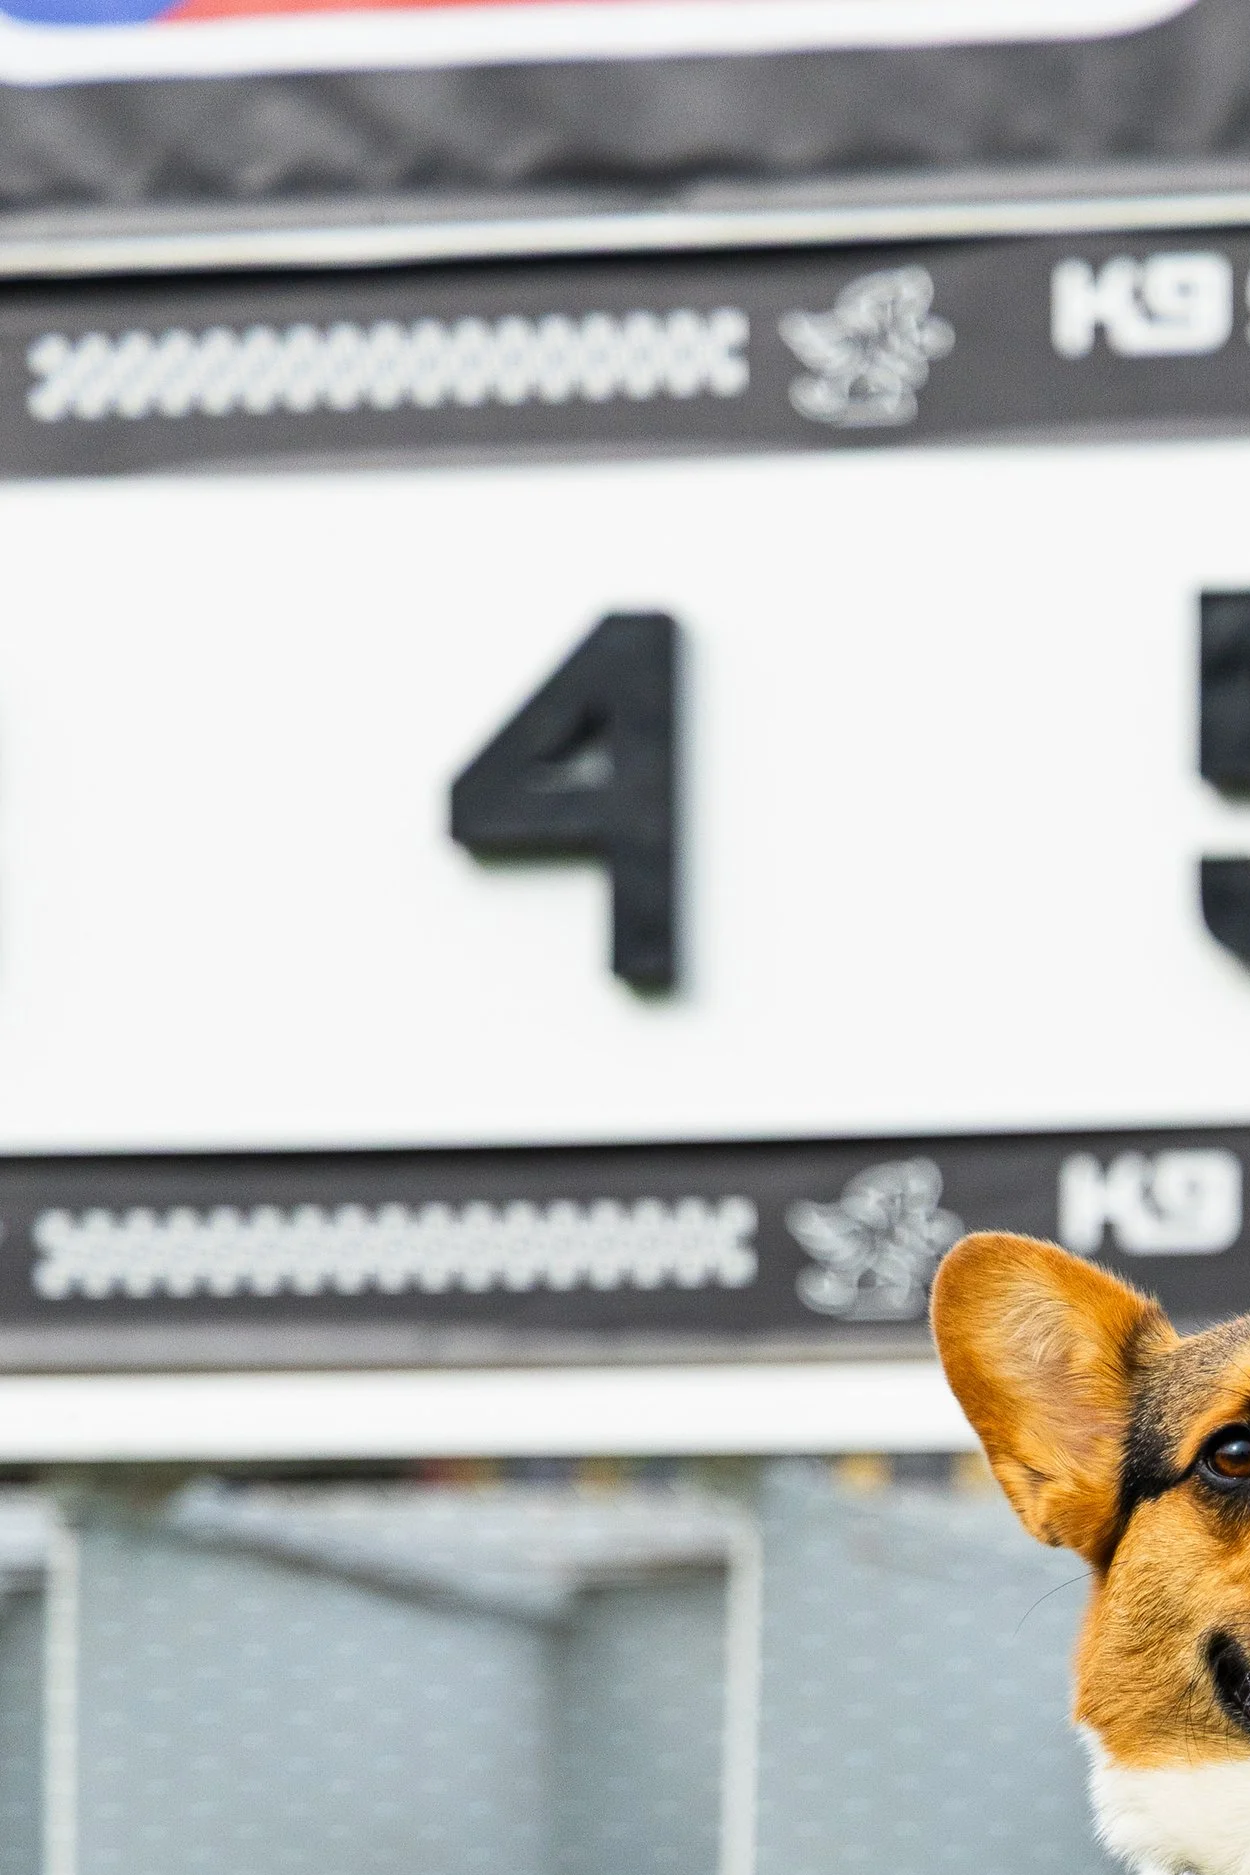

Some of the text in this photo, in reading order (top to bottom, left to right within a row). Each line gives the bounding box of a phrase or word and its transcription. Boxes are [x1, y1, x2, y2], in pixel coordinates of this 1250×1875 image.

[1050, 250, 1233, 358] K9
[447, 610, 688, 1003] 4
[1056, 1147, 1243, 1257] K9
